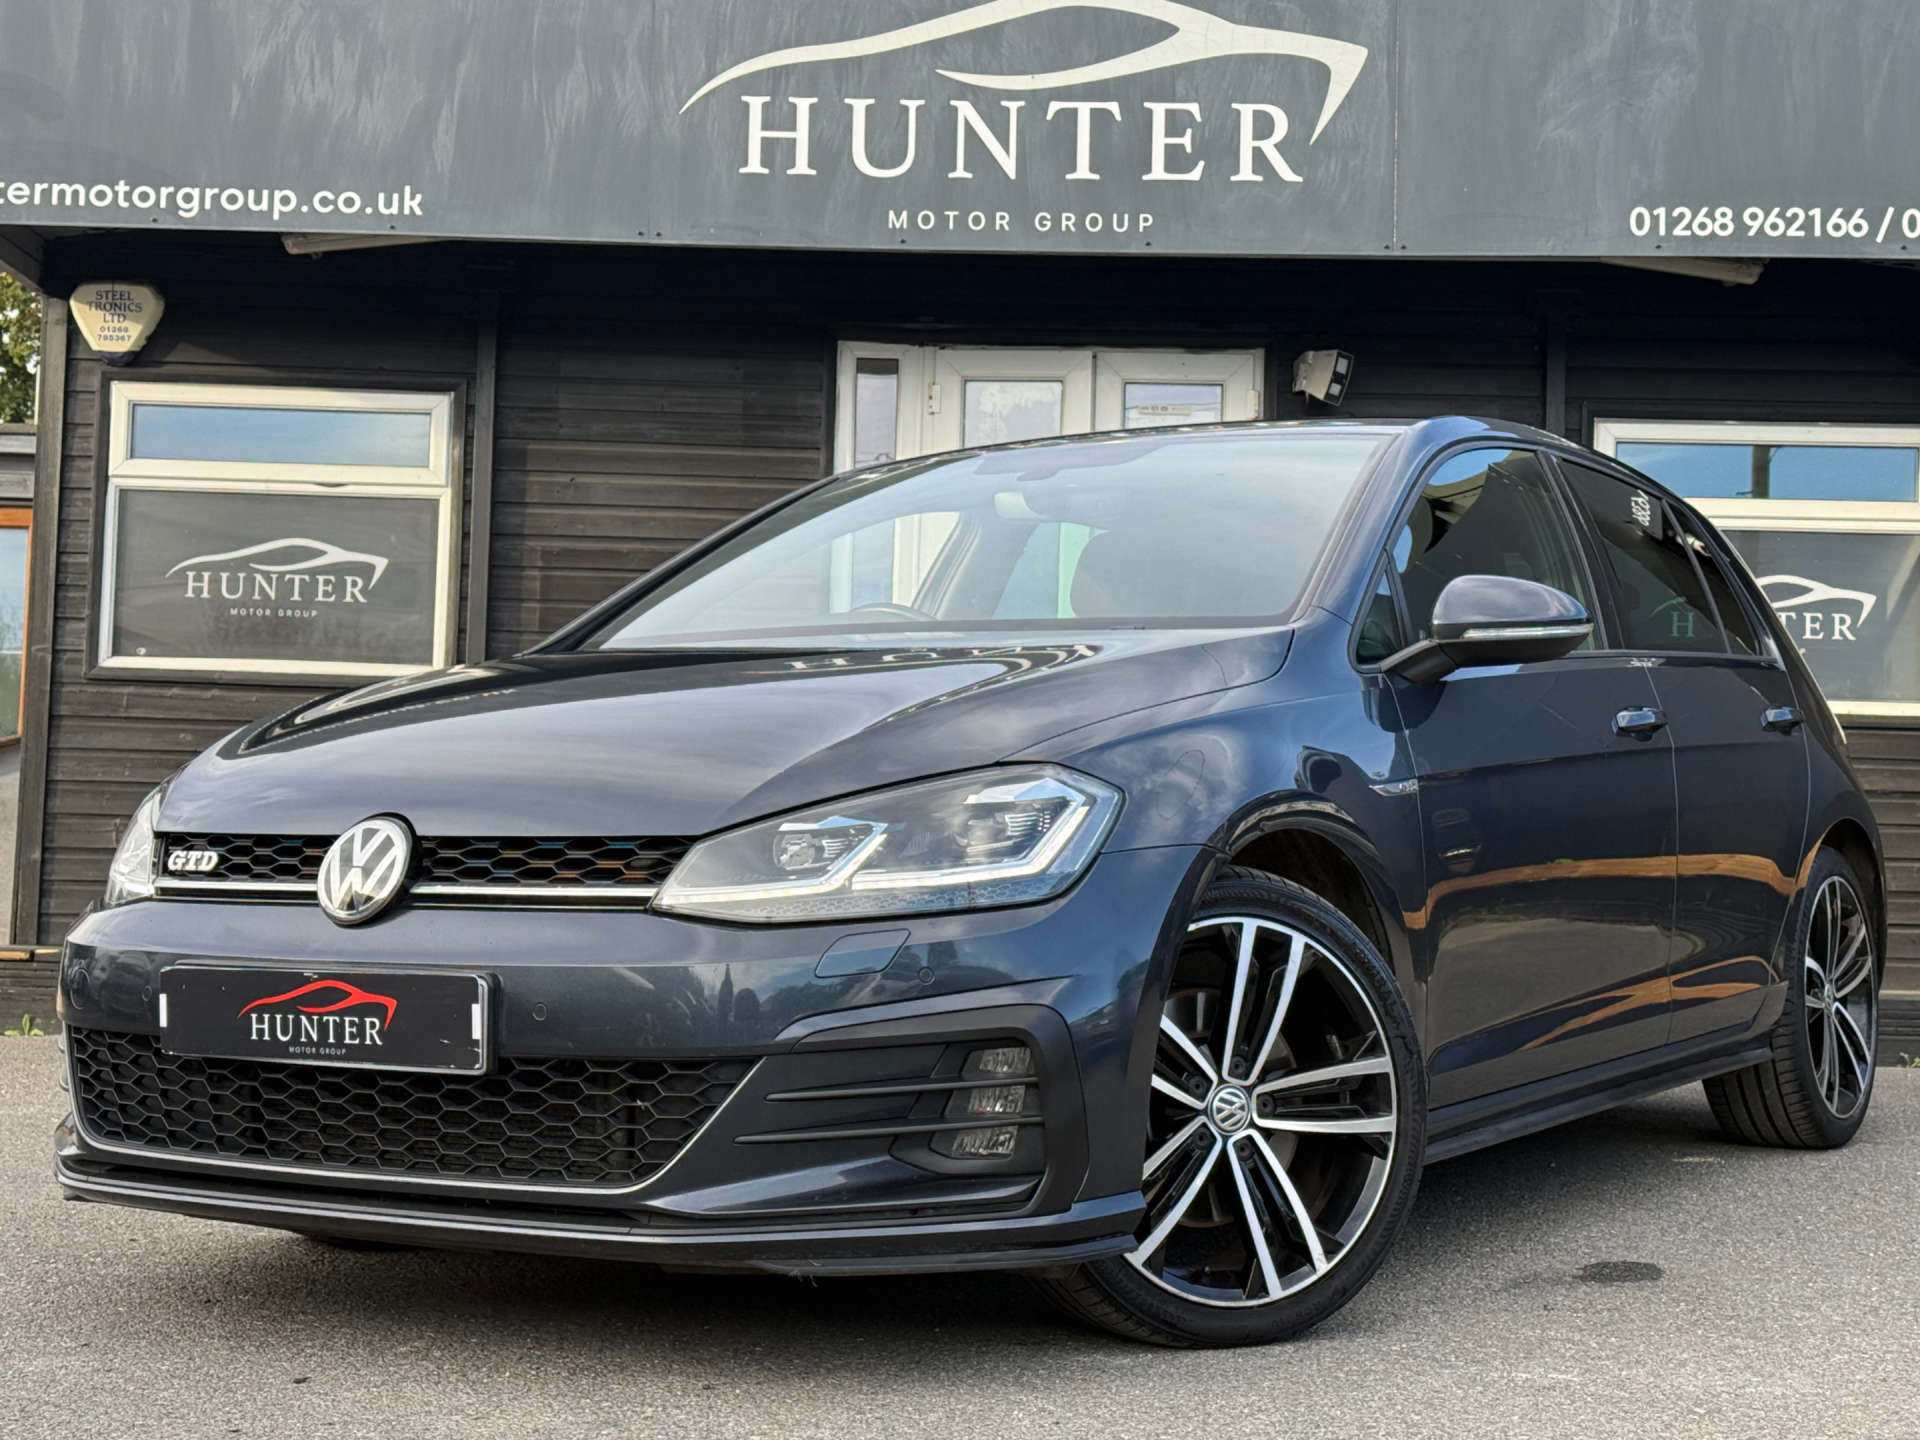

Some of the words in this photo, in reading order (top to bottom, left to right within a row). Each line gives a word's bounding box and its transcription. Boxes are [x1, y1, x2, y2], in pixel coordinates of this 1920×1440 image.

[738, 95, 1303, 182] HUNTER
[888, 210, 1010, 231] MOTOR
[1034, 212, 1154, 232] GROUP
[1630, 206, 1734, 237] 01268
[1743, 207, 1869, 238] 962166
[88, 301, 143, 312] TRONICS
[96, 290, 134, 301] STEEL
[104, 313, 127, 323] LTD
[184, 571, 367, 603] HUNTER
[230, 607, 271, 616] MOTOR
[278, 608, 318, 618] GROUP
[167, 850, 219, 872] GTD
[250, 1013, 383, 1046] HUNTER
[288, 1046, 316, 1055] MOTOR
[319, 1047, 347, 1056] GROUP
